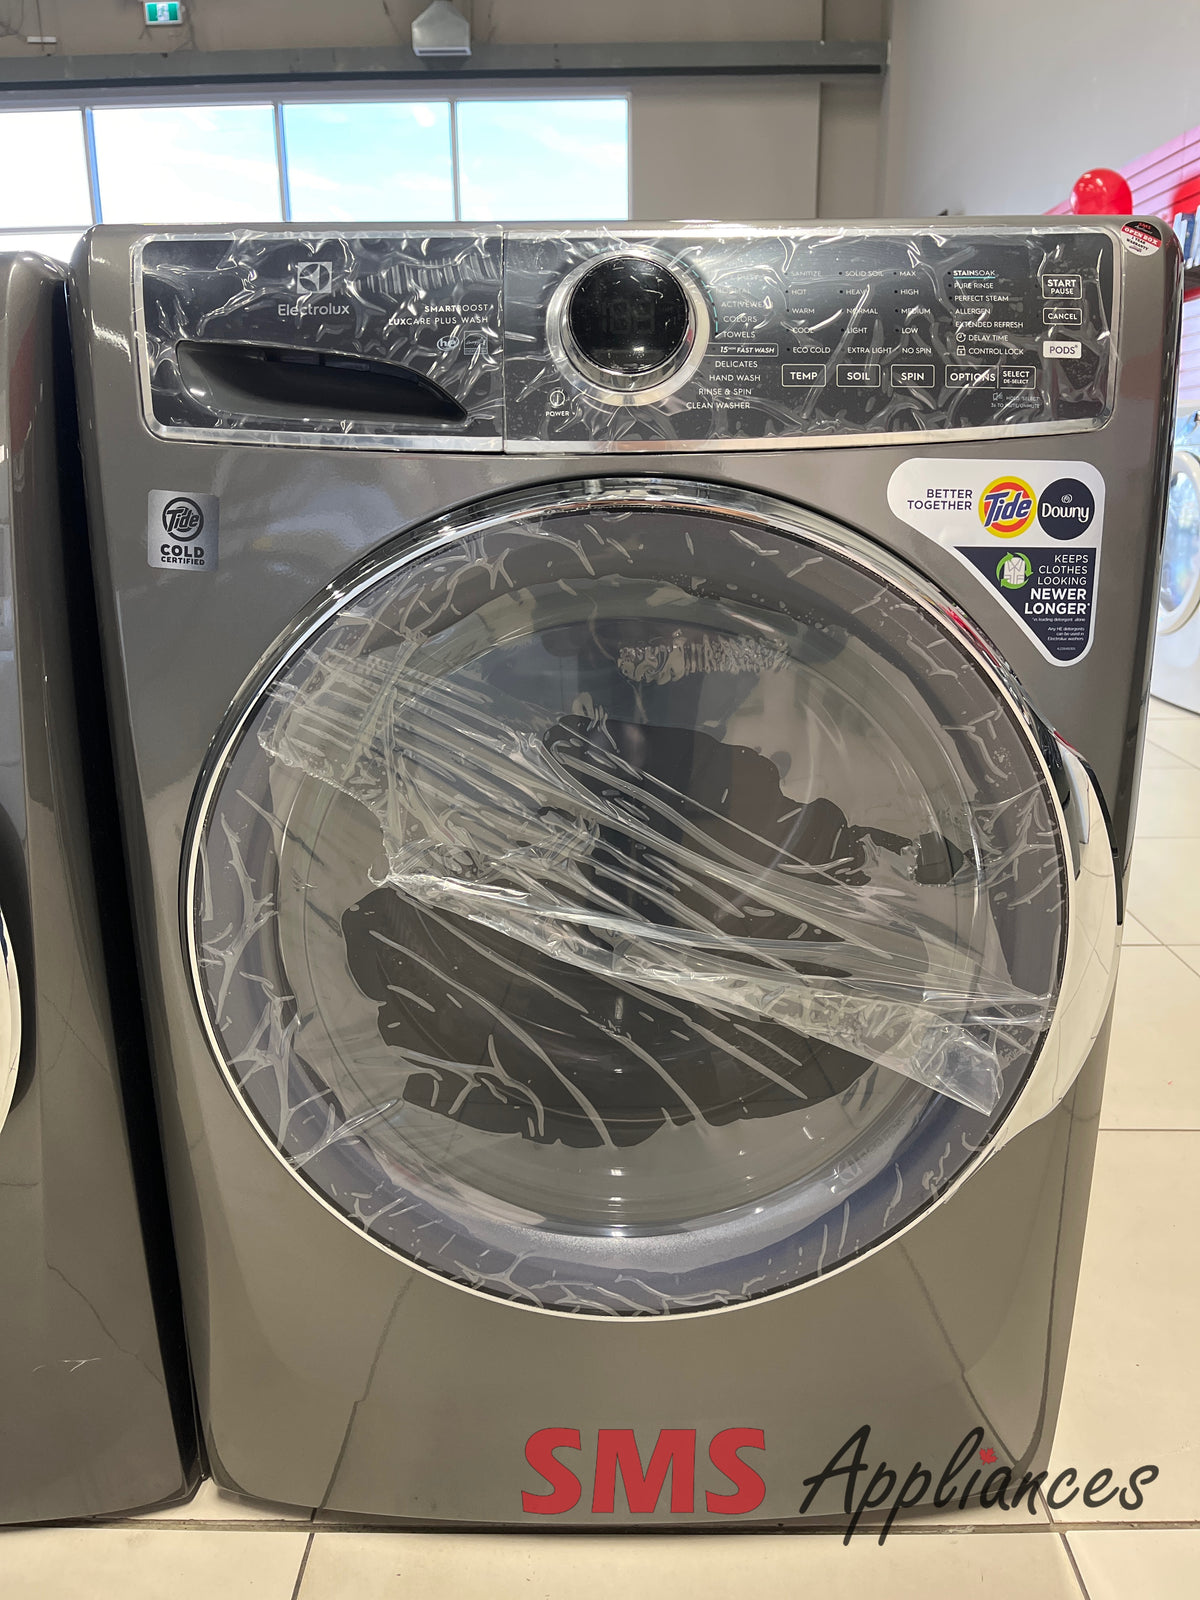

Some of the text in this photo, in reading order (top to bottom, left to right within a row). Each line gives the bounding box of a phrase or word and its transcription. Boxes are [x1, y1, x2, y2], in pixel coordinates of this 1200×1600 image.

[1124, 227, 1143, 239] OPEN
[1142, 235, 1158, 246] BOX
[1126, 238, 1149, 250] WARRANTY
[1047, 279, 1076, 288] START
[278, 303, 350, 317] Electrolux
[388, 316, 489, 326] LUXCARE PLUS WASH
[1048, 312, 1078, 320] CANCEL
[968, 334, 1008, 342] DELAY TIME
[736, 346, 754, 354] FAST
[754, 346, 775, 354] WASH
[792, 346, 831, 354] ECO COLD
[968, 348, 1024, 356] CONTROL LOCK
[714, 360, 758, 368] DELICATES
[708, 374, 761, 382] HAND WASH
[790, 371, 818, 380] TEMP
[846, 372, 870, 381] SOIL
[900, 372, 925, 382] SPIN
[950, 372, 996, 382] OPTIONS
[1002, 370, 1030, 378] SELECT
[698, 388, 752, 396] RINSE & SPIN
[686, 402, 751, 410] CLEAN WASHER
[926, 488, 972, 499] BETTER
[907, 500, 972, 511] TOGETHER
[984, 491, 1032, 528] Tide
[1042, 502, 1090, 523] Downy
[166, 508, 200, 532] Tide
[160, 544, 204, 558] COLD
[160, 556, 205, 566] CERTIFIED
[1054, 554, 1089, 564] KEEPS
[1038, 566, 1088, 574] CLOTHES
[1038, 576, 1087, 586] LOOKING
[1030, 588, 1087, 600] NEWER
